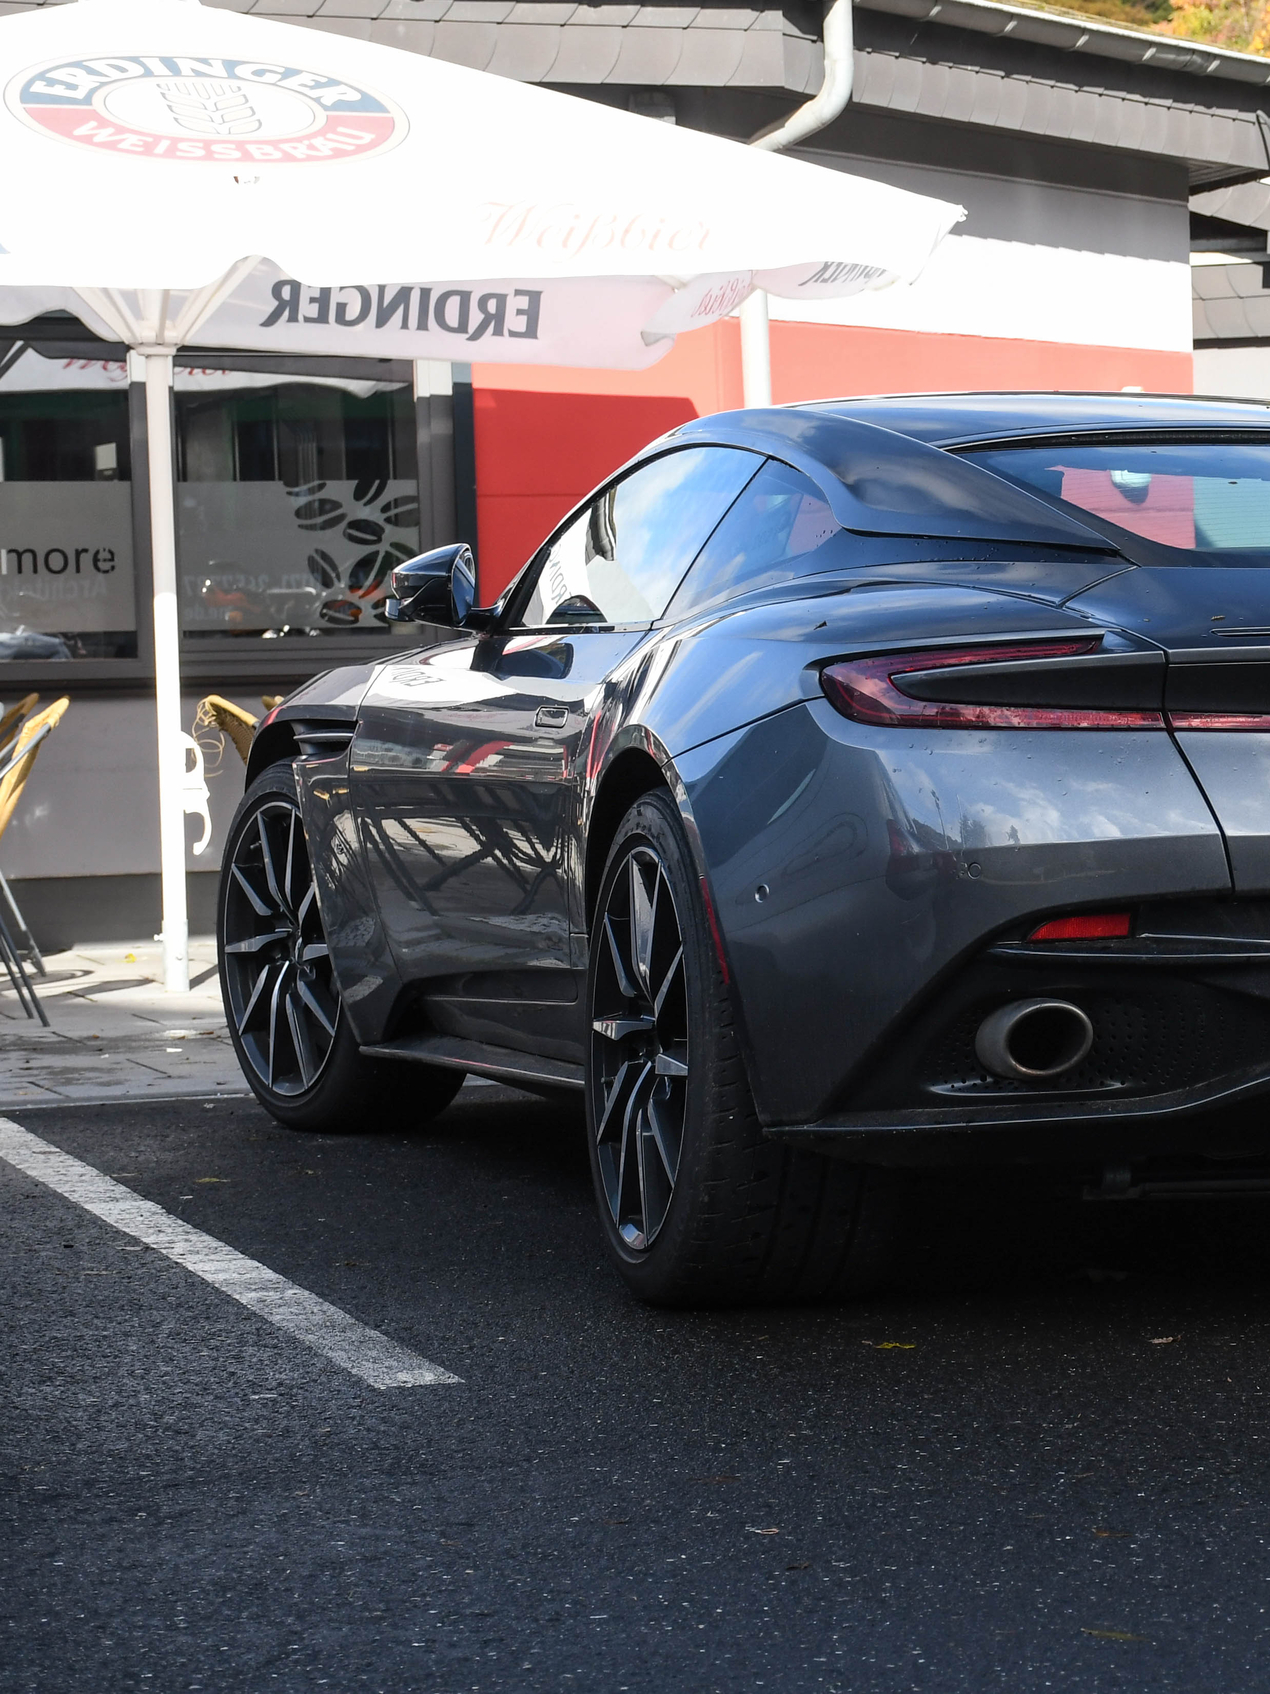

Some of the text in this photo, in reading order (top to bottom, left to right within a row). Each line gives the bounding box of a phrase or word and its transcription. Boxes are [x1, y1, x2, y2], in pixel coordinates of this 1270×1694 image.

[30, 57, 363, 107] ERDINGER
[72, 120, 376, 161] WEISSBRÄU
[476, 199, 711, 263] Weißbier
[1, 547, 116, 575] more
